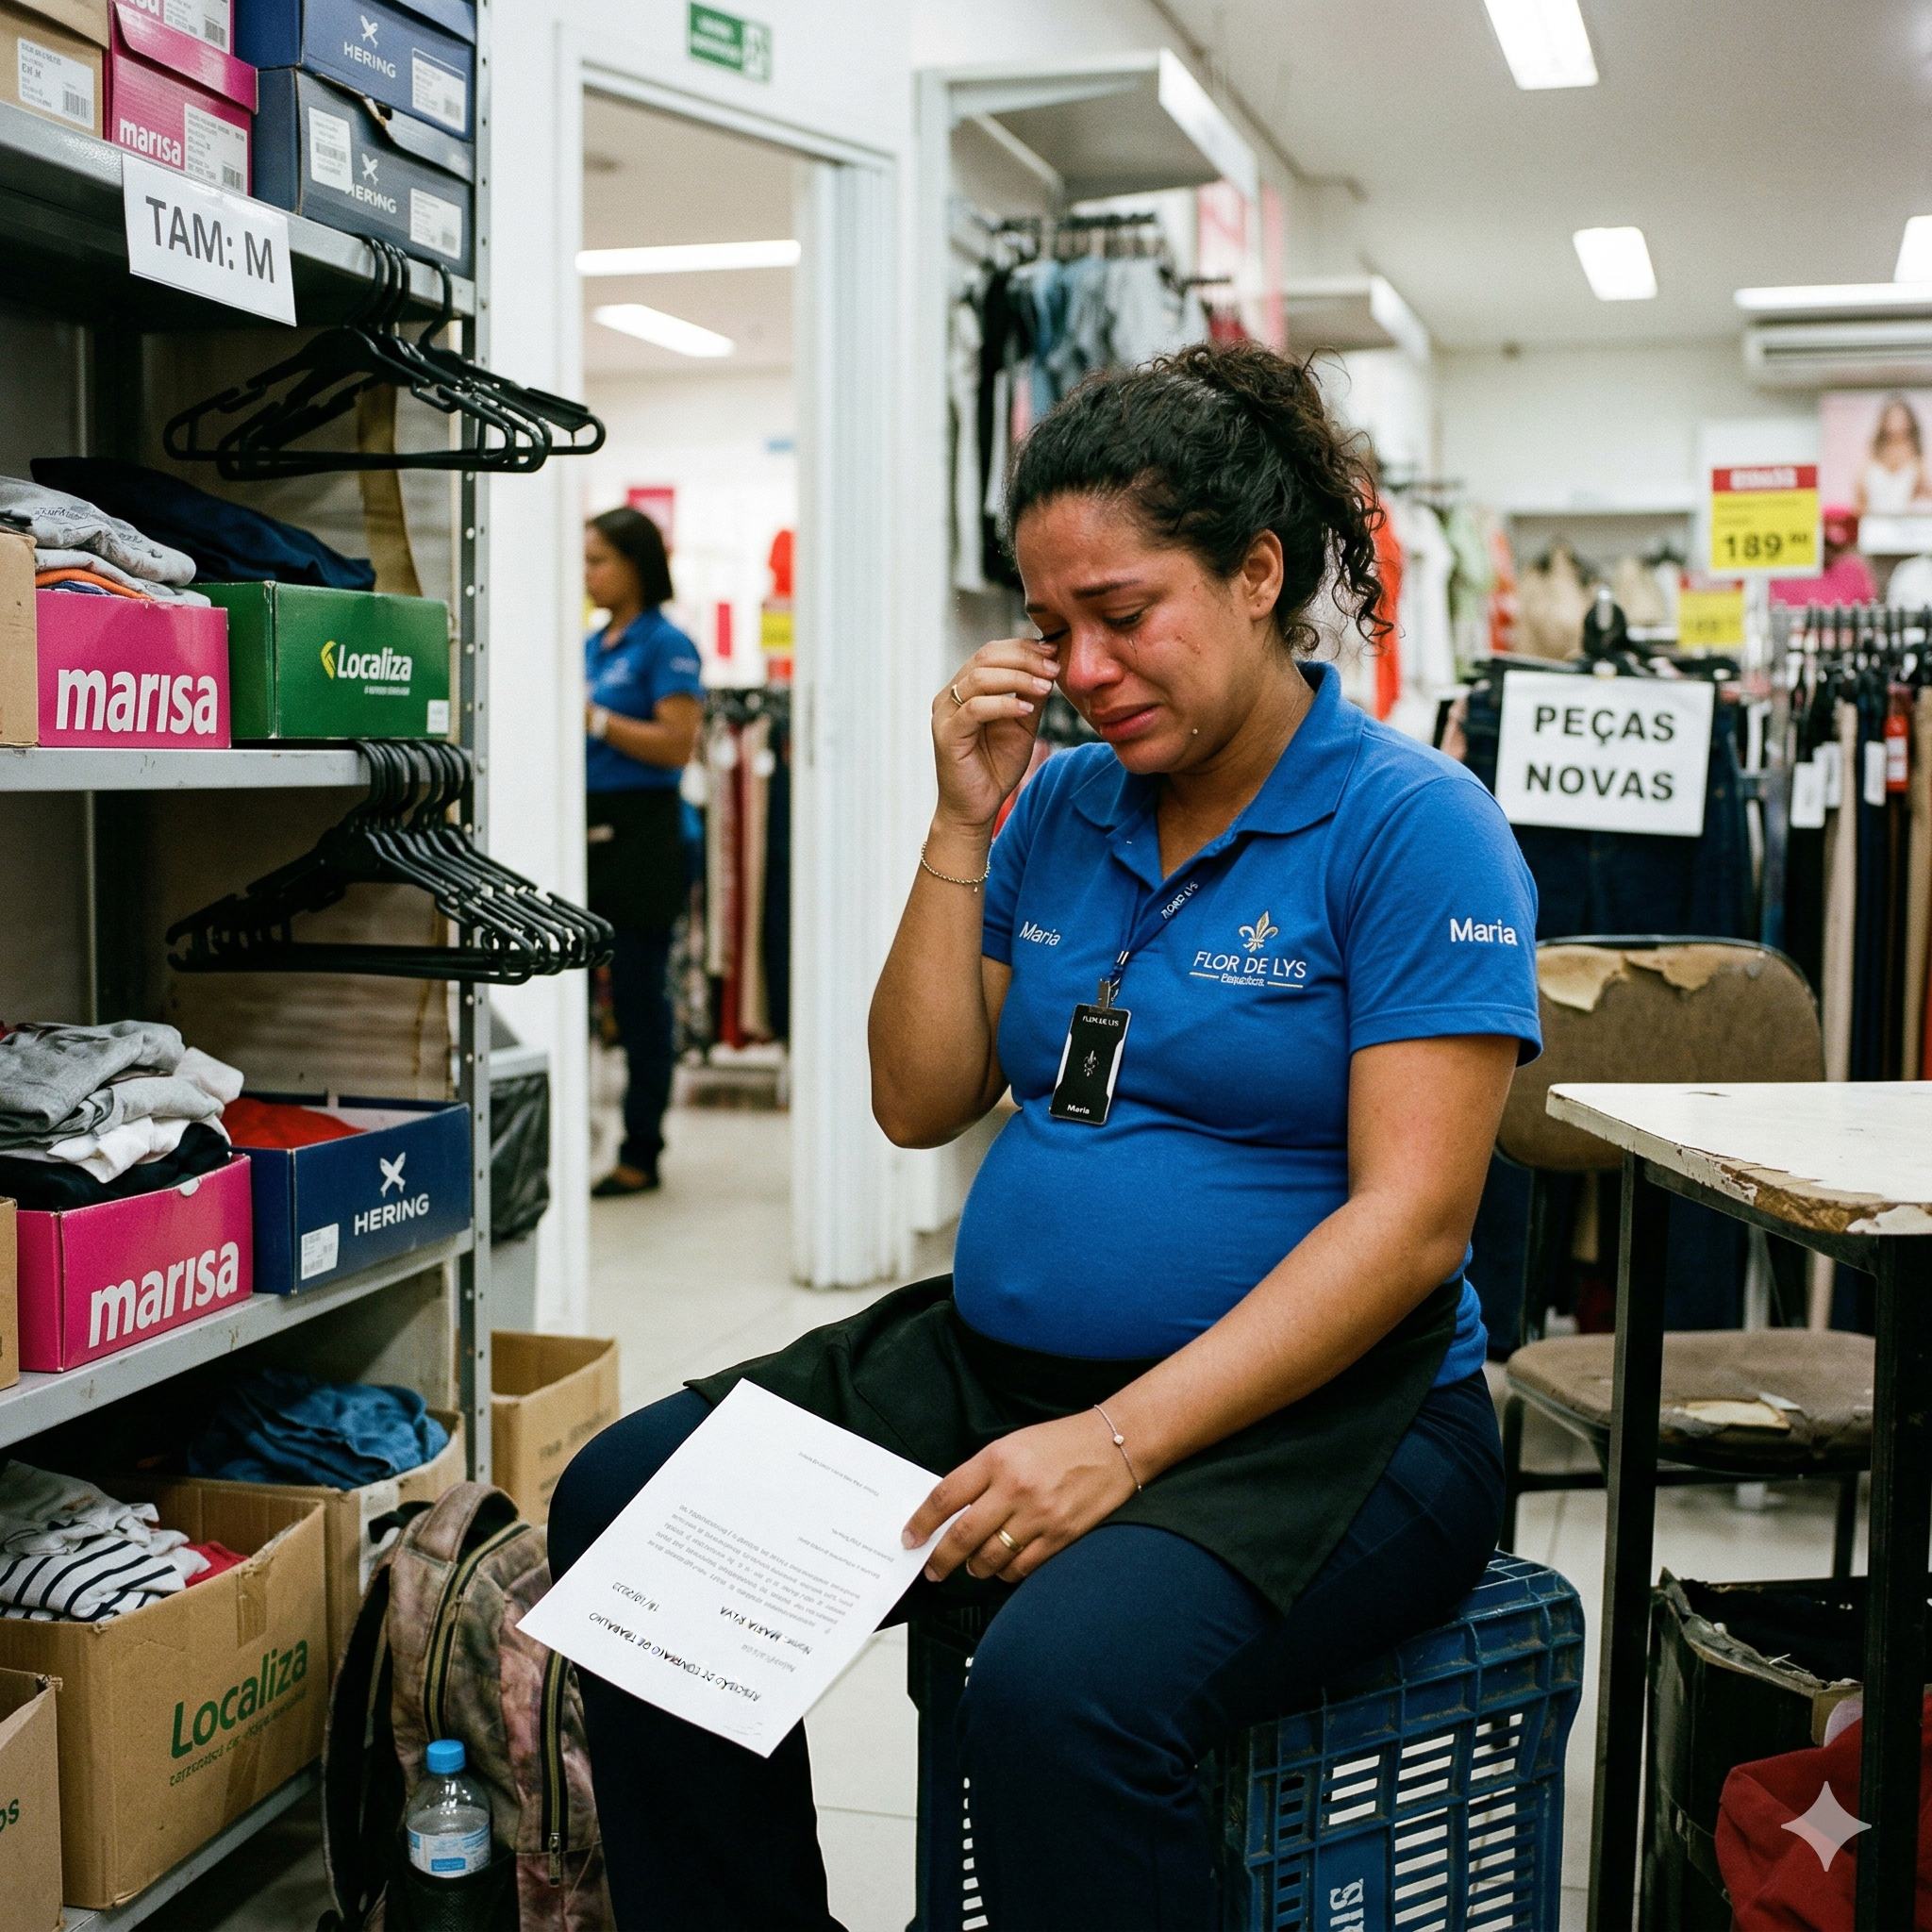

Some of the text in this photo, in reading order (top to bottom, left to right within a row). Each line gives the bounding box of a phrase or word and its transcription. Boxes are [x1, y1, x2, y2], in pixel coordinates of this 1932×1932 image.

[343, 41, 396, 79] HERING
[119, 117, 183, 167] marisa
[145, 195, 275, 284] TAM: M
[1724, 532, 1783, 559] 189
[337, 643, 413, 682] Localiza
[56, 668, 218, 735] marisa
[1534, 705, 1675, 744] PEÇAS
[1525, 762, 1674, 802] NOVAS
[1019, 920, 1061, 947] Maria
[1450, 917, 1518, 945] Maria
[1193, 951, 1307, 979] FLOR DE LYS
[354, 1191, 430, 1236] HERING
[88, 1241, 240, 1349] marisa
[170, 1639, 308, 1759] Localiza
